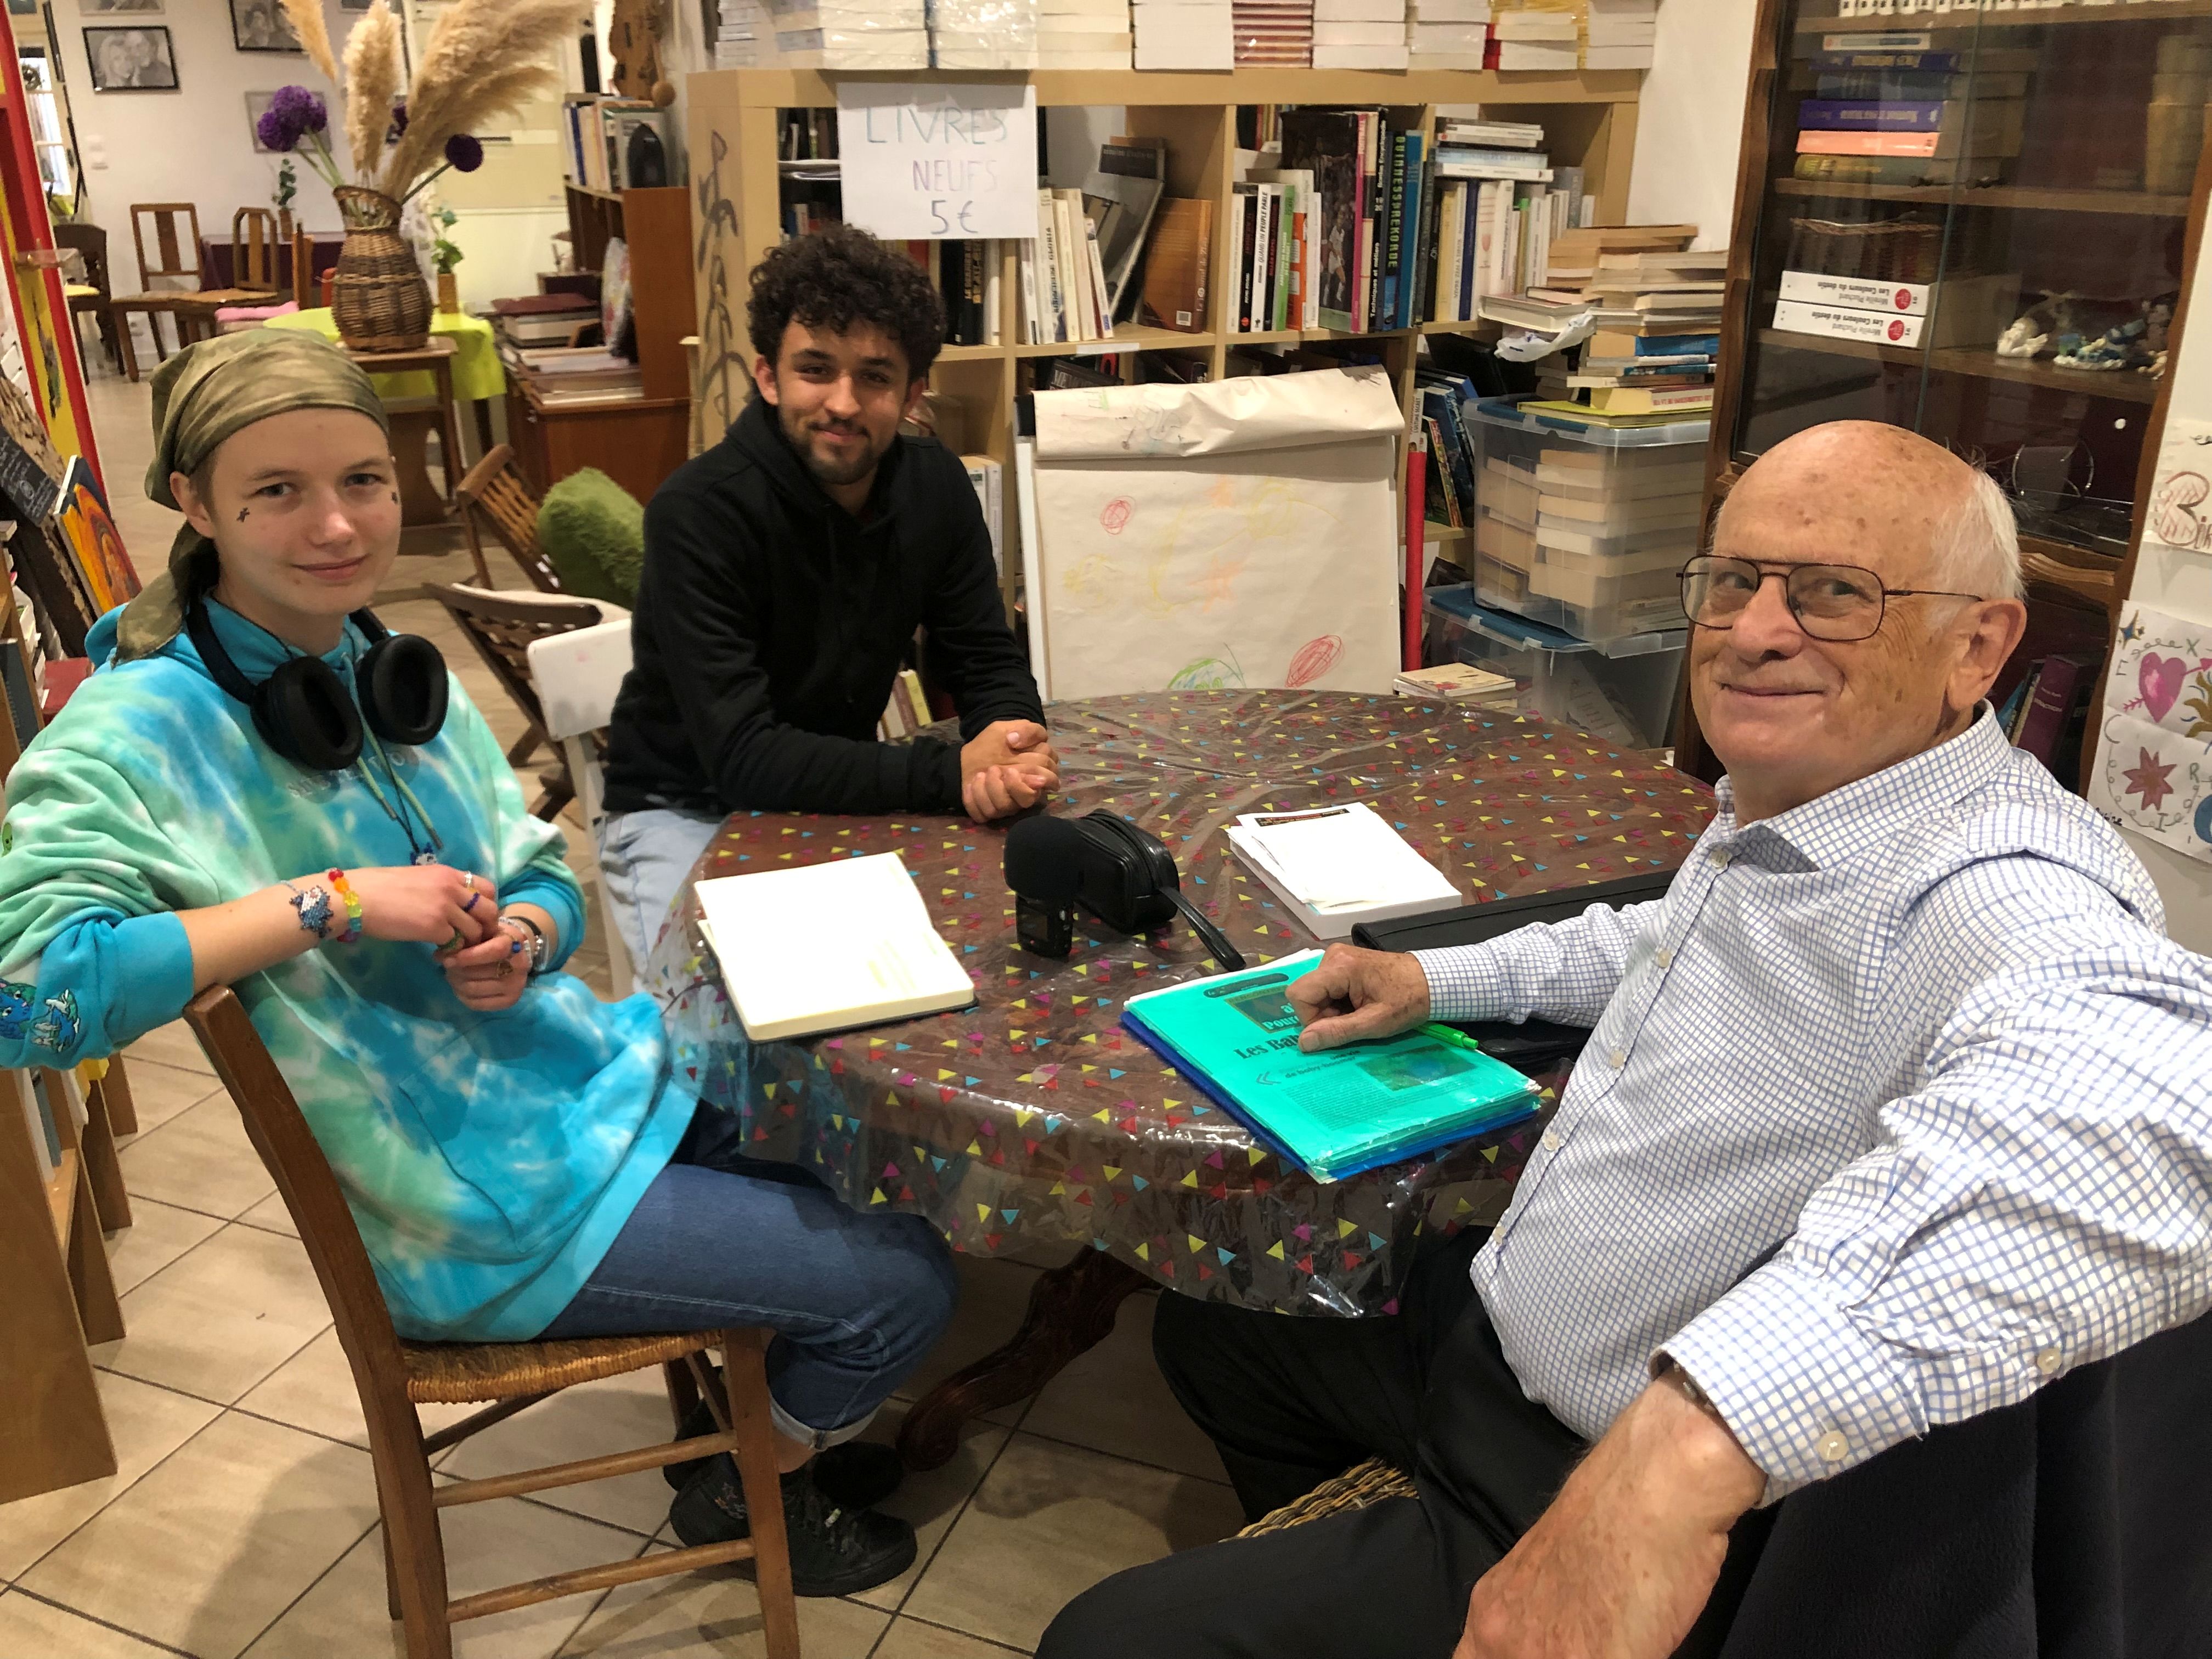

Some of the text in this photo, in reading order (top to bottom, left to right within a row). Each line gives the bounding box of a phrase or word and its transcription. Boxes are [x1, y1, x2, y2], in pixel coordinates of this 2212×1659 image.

[866, 103, 1008, 145] LIVRES
[912, 160, 998, 193] NEUFS
[1257, 234, 1265, 242] UN
[1848, 285, 1876, 295] Couleurs
[1879, 288, 1889, 296] Les
[1812, 312, 1831, 320] destin
[1843, 315, 1871, 325] Couleurs
[1233, 1034, 1299, 1059] Les Bab
[1297, 1056, 1356, 1075] baby-boomer
